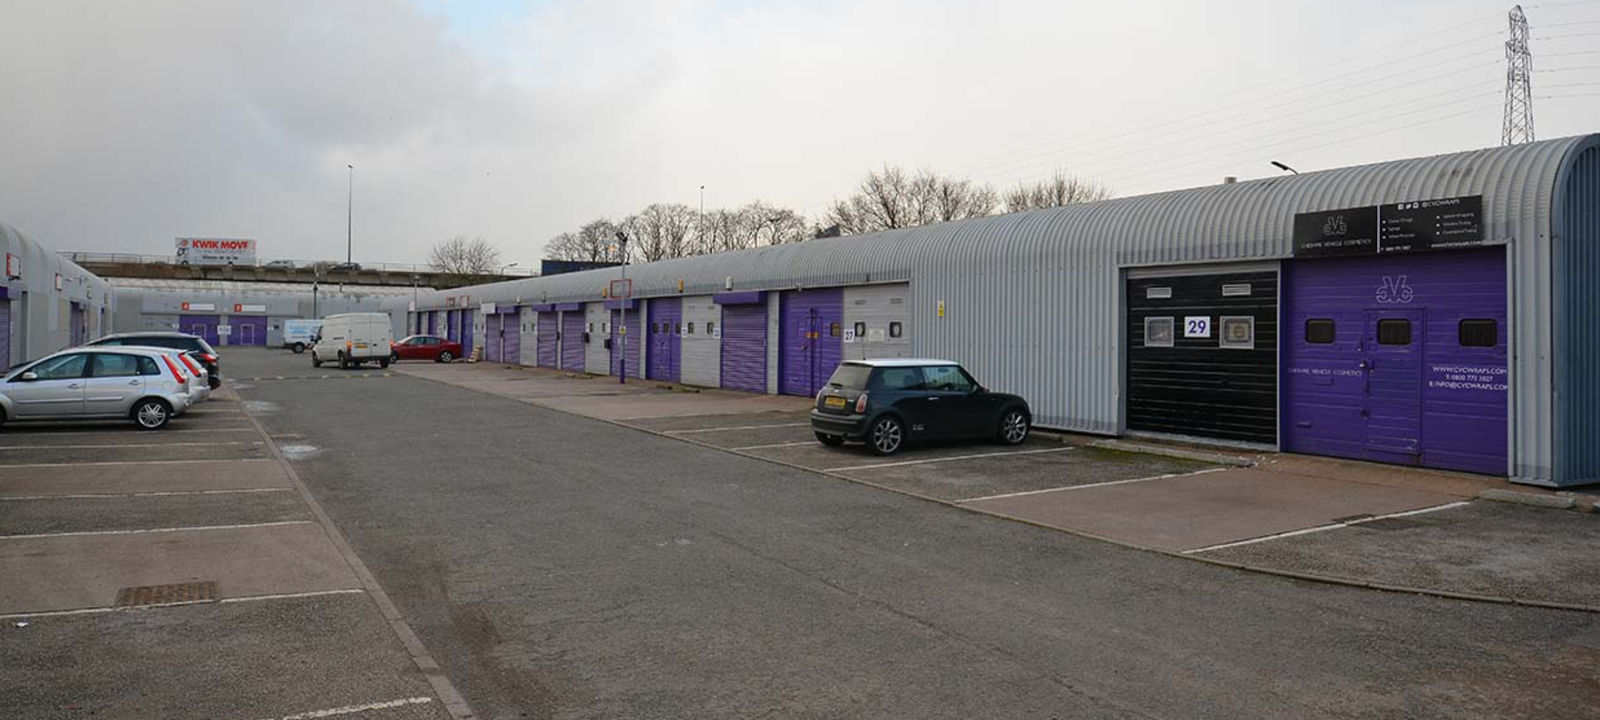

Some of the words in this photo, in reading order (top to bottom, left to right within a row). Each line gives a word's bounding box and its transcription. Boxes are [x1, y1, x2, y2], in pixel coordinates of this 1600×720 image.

[192, 239, 219, 249] KWIK
[220, 240, 249, 250] MOVE
[1188, 320, 1206, 334] 29
[845, 331, 853, 340] 27
